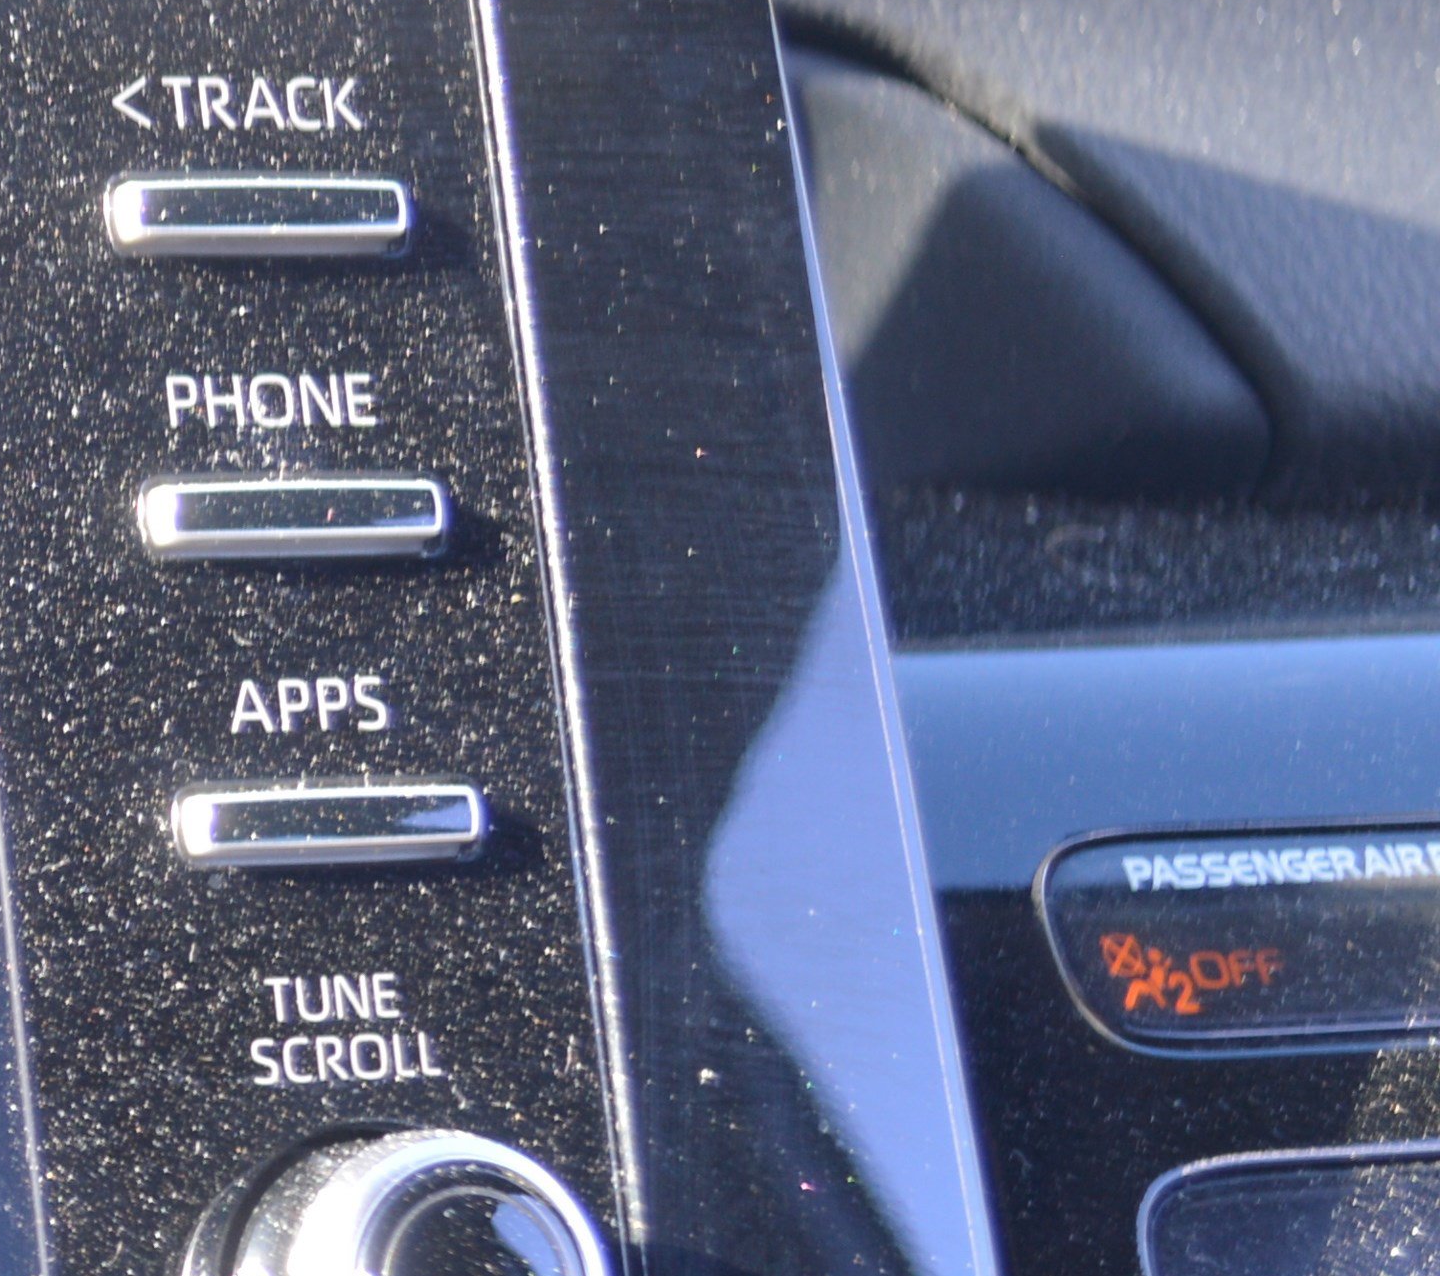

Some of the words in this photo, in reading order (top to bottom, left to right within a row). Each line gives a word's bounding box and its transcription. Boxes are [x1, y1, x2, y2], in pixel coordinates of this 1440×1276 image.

[161, 76, 364, 131] TRACK
[165, 373, 378, 427] PHONE
[230, 675, 389, 734] APPS
[1122, 846, 1364, 892] PASSENGER
[1365, 842, 1429, 880] AIR
[1188, 946, 1285, 991] OFF
[264, 972, 403, 1024] TUNE
[249, 1032, 443, 1086] SCROLL
